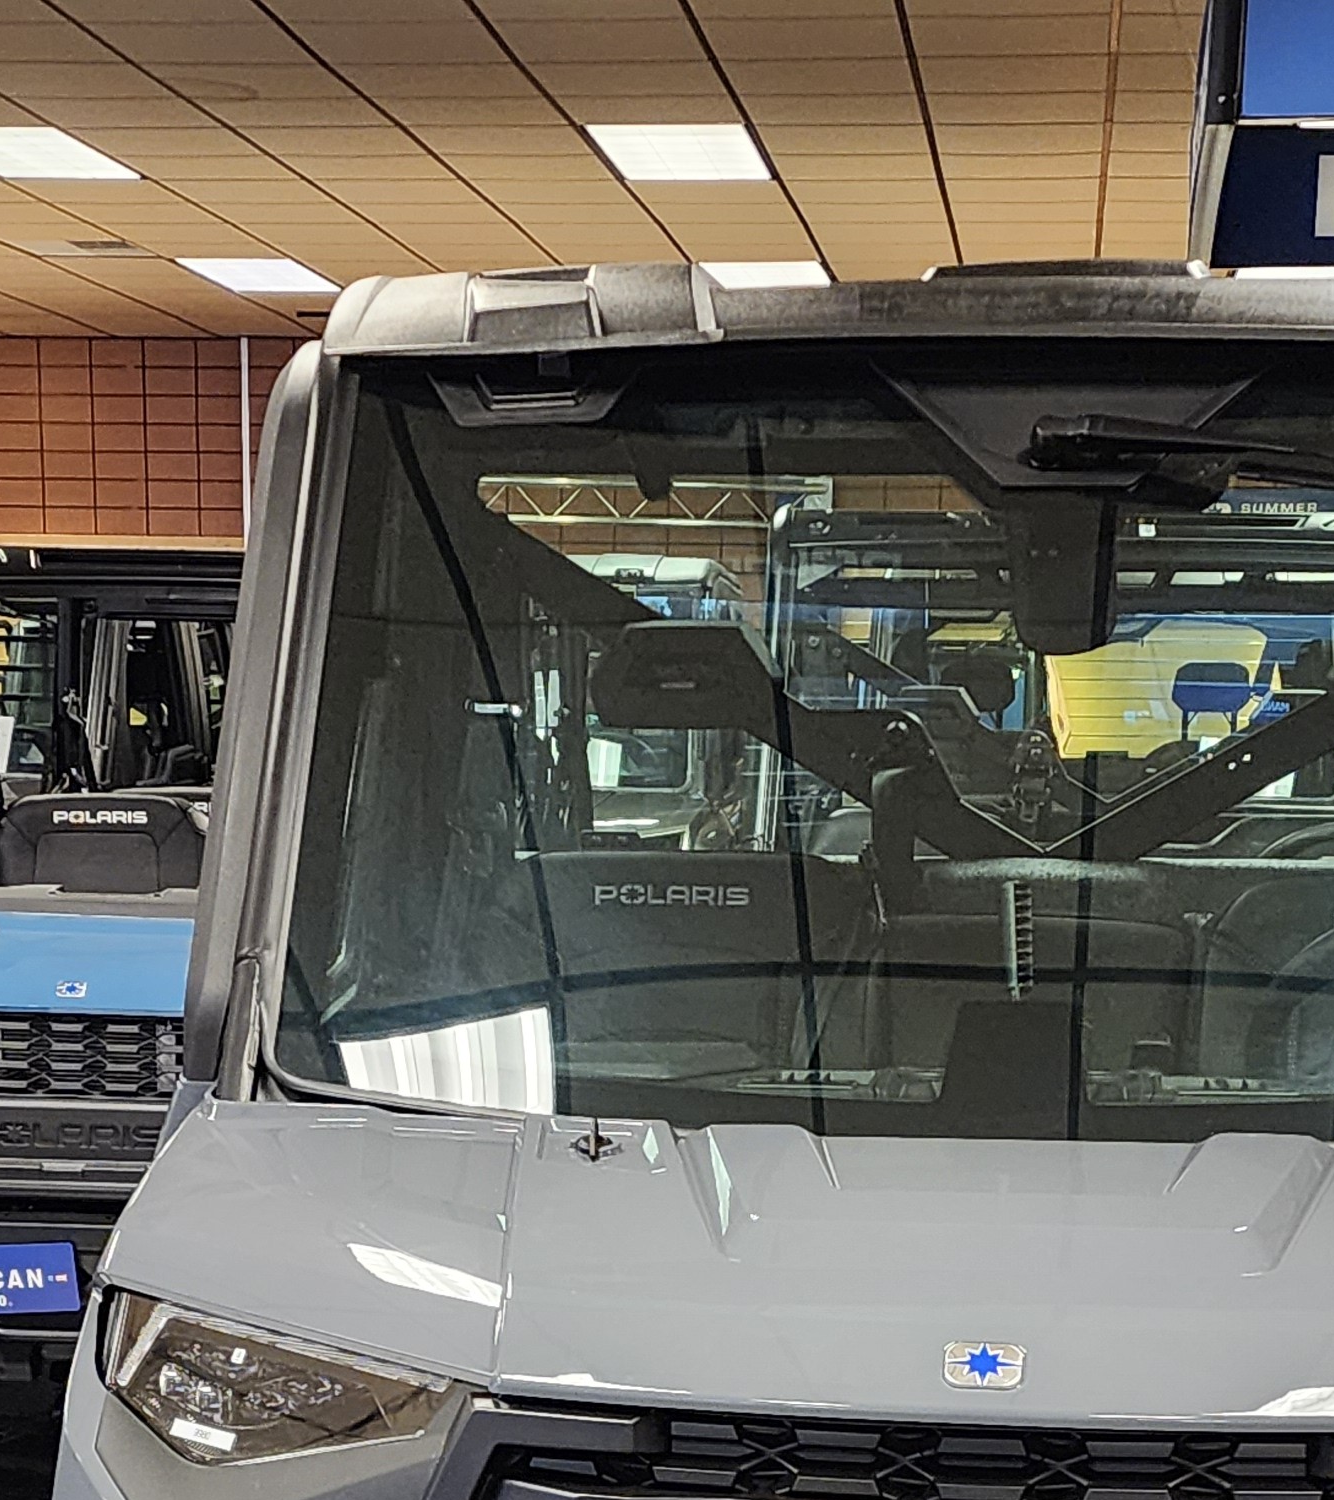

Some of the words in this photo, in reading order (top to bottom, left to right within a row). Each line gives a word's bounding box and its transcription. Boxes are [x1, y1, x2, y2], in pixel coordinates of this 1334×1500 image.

[1240, 502, 1317, 513] SUMMER
[53, 810, 148, 824] POLARIS
[594, 884, 750, 906] POLARIS
